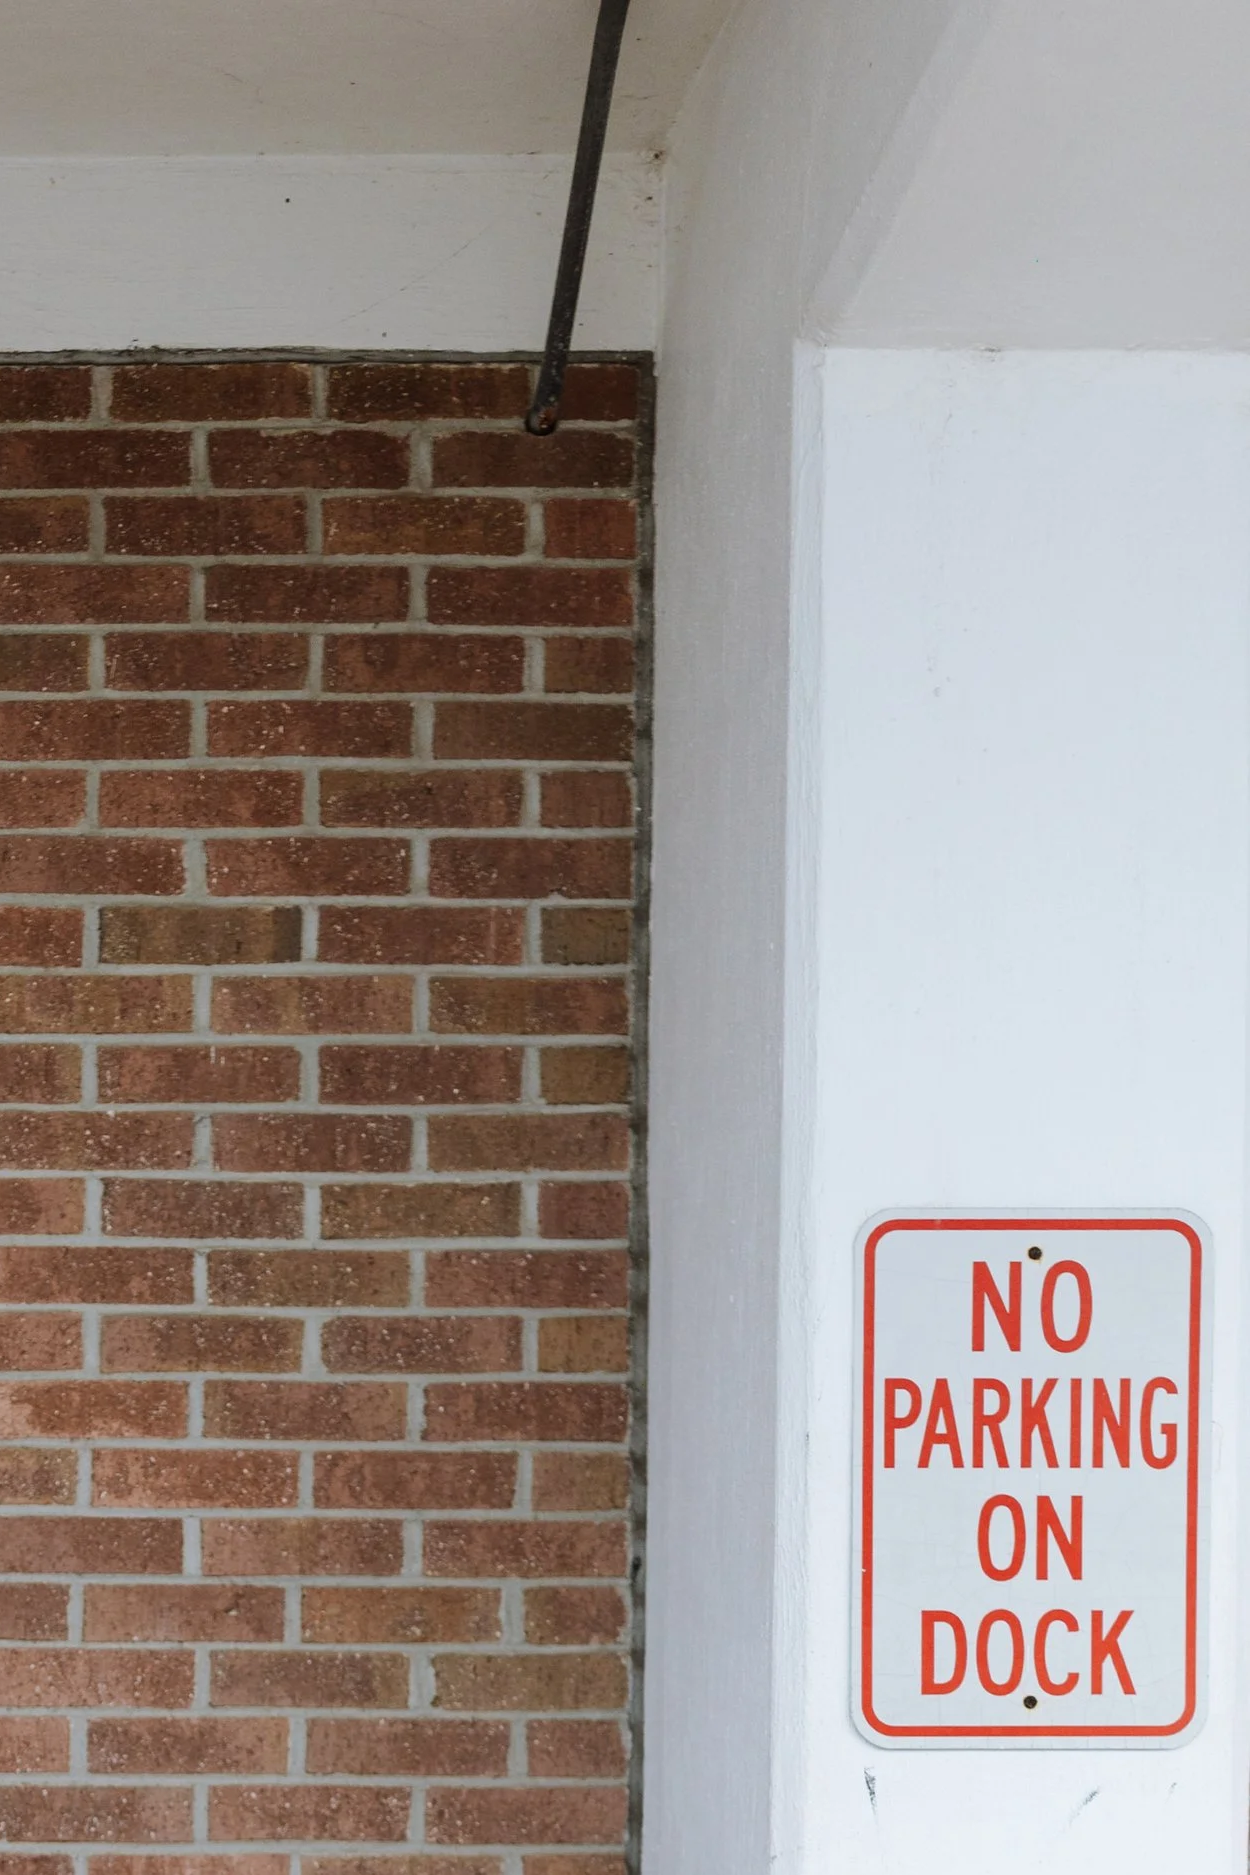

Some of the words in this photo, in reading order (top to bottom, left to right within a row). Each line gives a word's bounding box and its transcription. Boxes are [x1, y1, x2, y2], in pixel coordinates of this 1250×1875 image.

[972, 1261, 1092, 1353] NO
[884, 1377, 1177, 1469] PARKING
[978, 1494, 1082, 1581] ON
[921, 1609, 1135, 1696] DOCK
